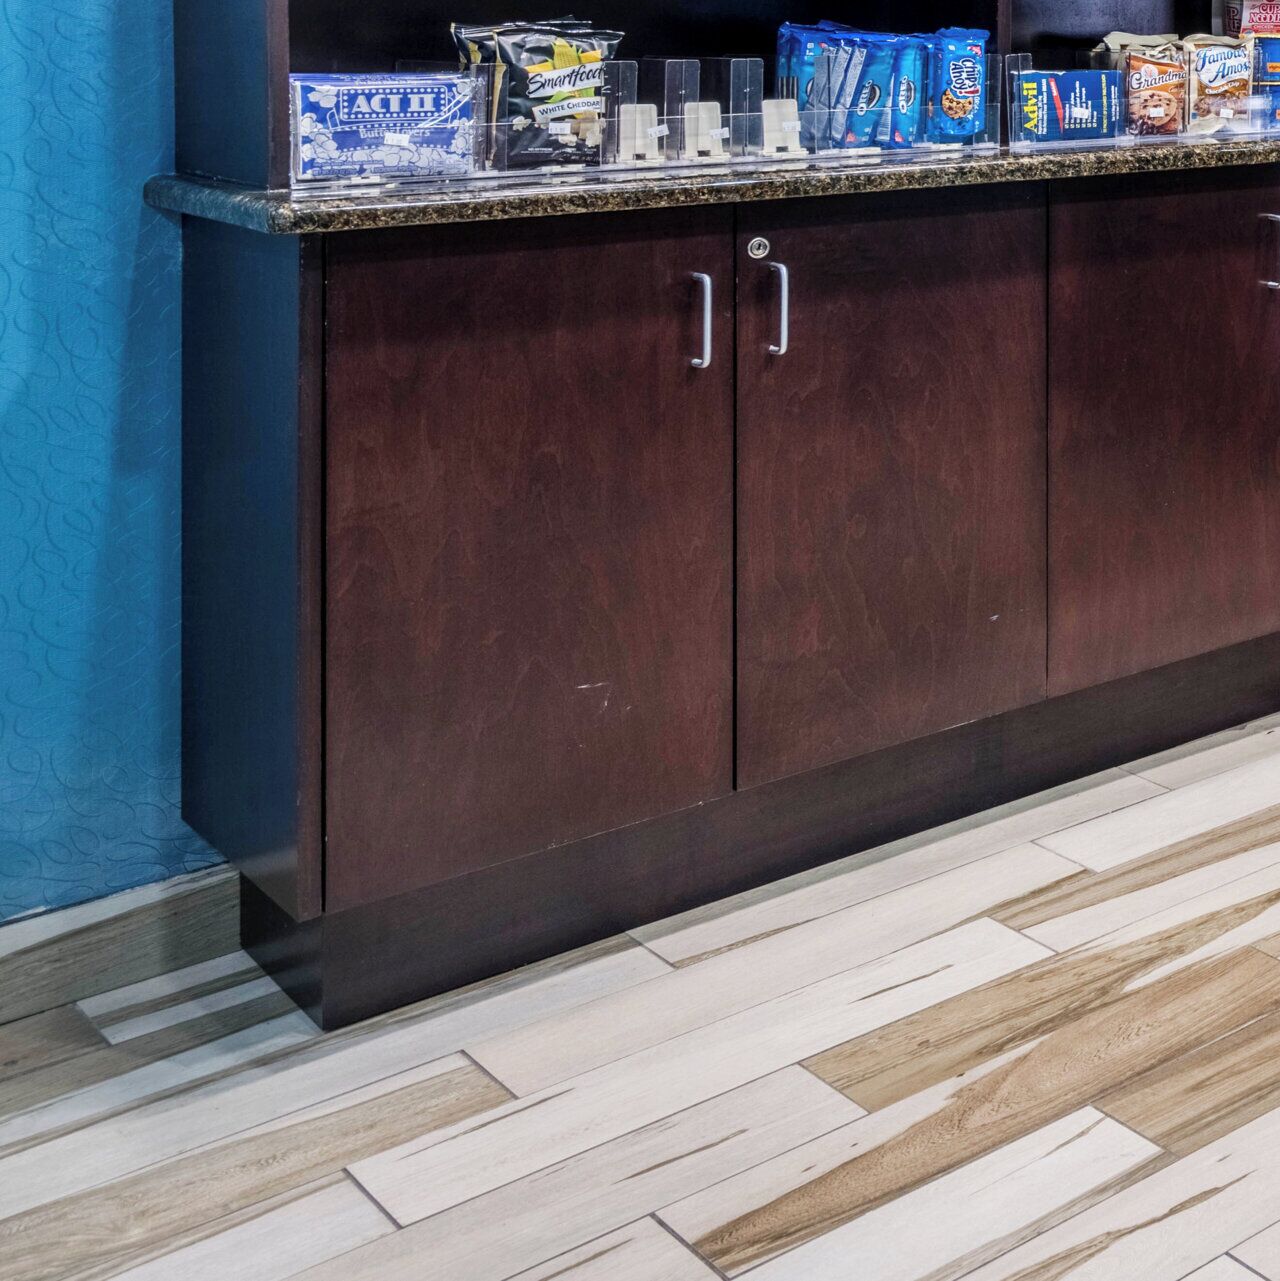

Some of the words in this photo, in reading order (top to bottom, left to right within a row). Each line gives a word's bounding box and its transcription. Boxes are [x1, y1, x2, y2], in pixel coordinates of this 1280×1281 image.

[960, 58, 980, 93] Chips
[1196, 46, 1247, 72] Famous
[1208, 61, 1250, 84] Amos
[526, 64, 605, 95] Smartfood
[899, 75, 908, 114] OREO
[950, 61, 973, 98] Ahoy!
[352, 94, 403, 113] ACT
[408, 94, 436, 112] II
[538, 104, 567, 116] WHITE
[567, 100, 601, 111] CHEDDAR
[857, 80, 873, 116] OREO
[1022, 82, 1038, 134] Advil
